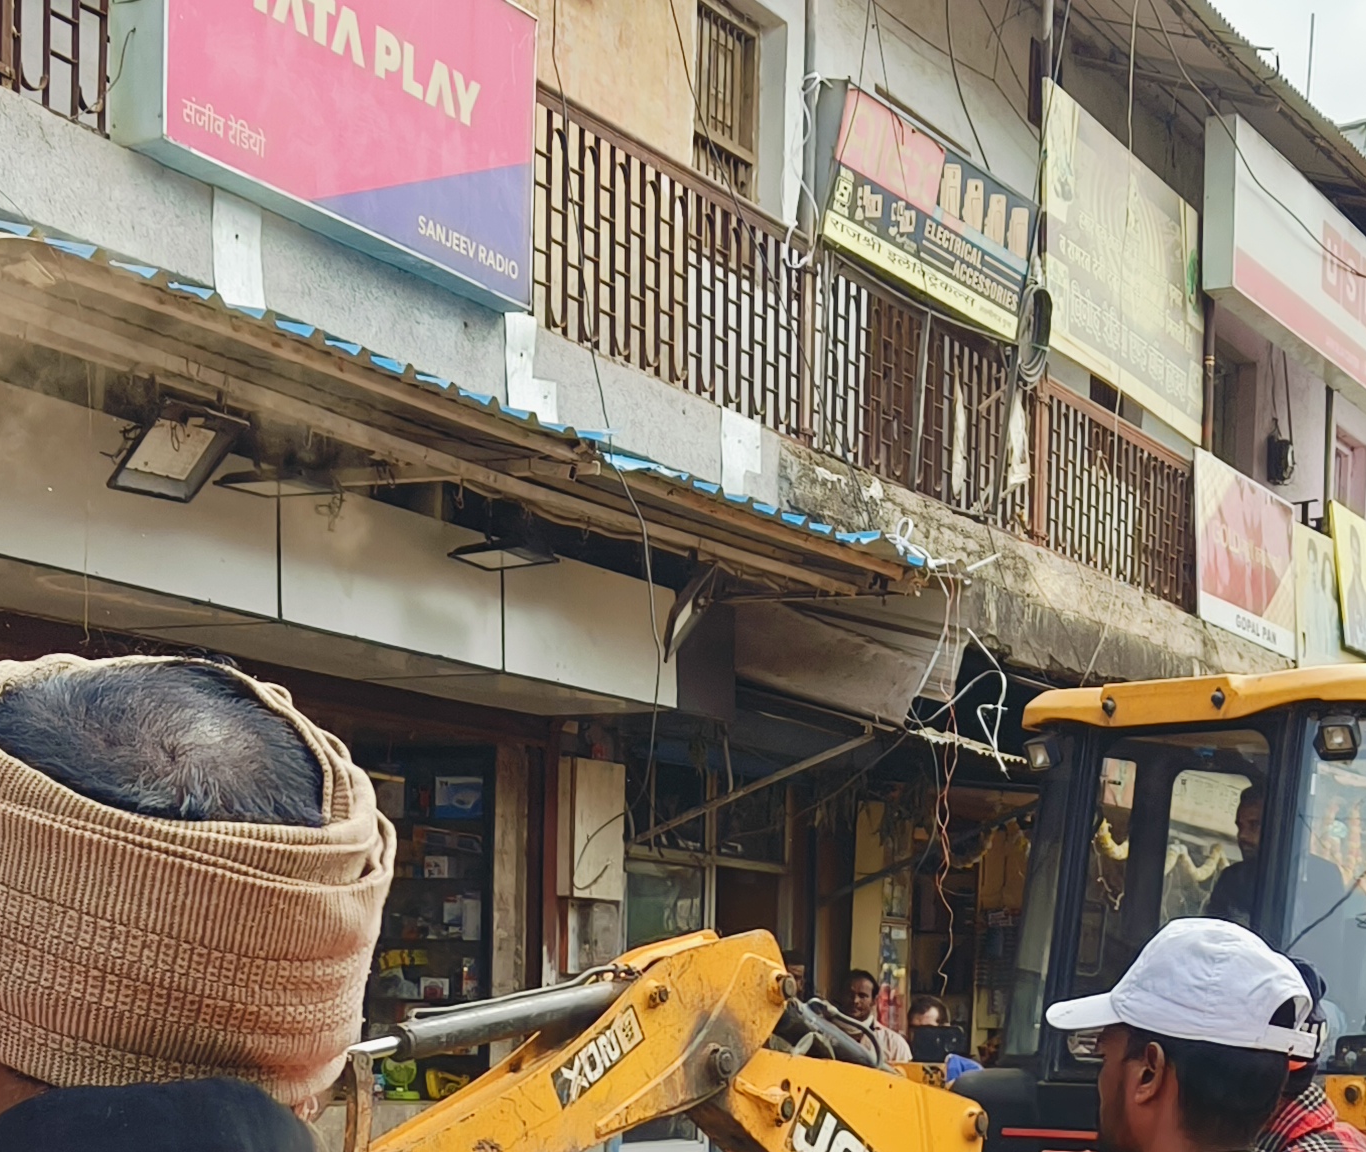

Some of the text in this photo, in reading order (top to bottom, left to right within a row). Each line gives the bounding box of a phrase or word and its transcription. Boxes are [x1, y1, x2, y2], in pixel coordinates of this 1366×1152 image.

[252, 0, 481, 127] ATA PLAY
[181, 96, 266, 158] संजीव रेडियो
[417, 215, 520, 281] SANJEEV RADIO
[830, 216, 883, 255] राजश्री
[923, 218, 985, 269] ELECTRICAL
[951, 260, 1019, 312] ACCESSORIES
[1235, 613, 1278, 646] GOPAL PAN
